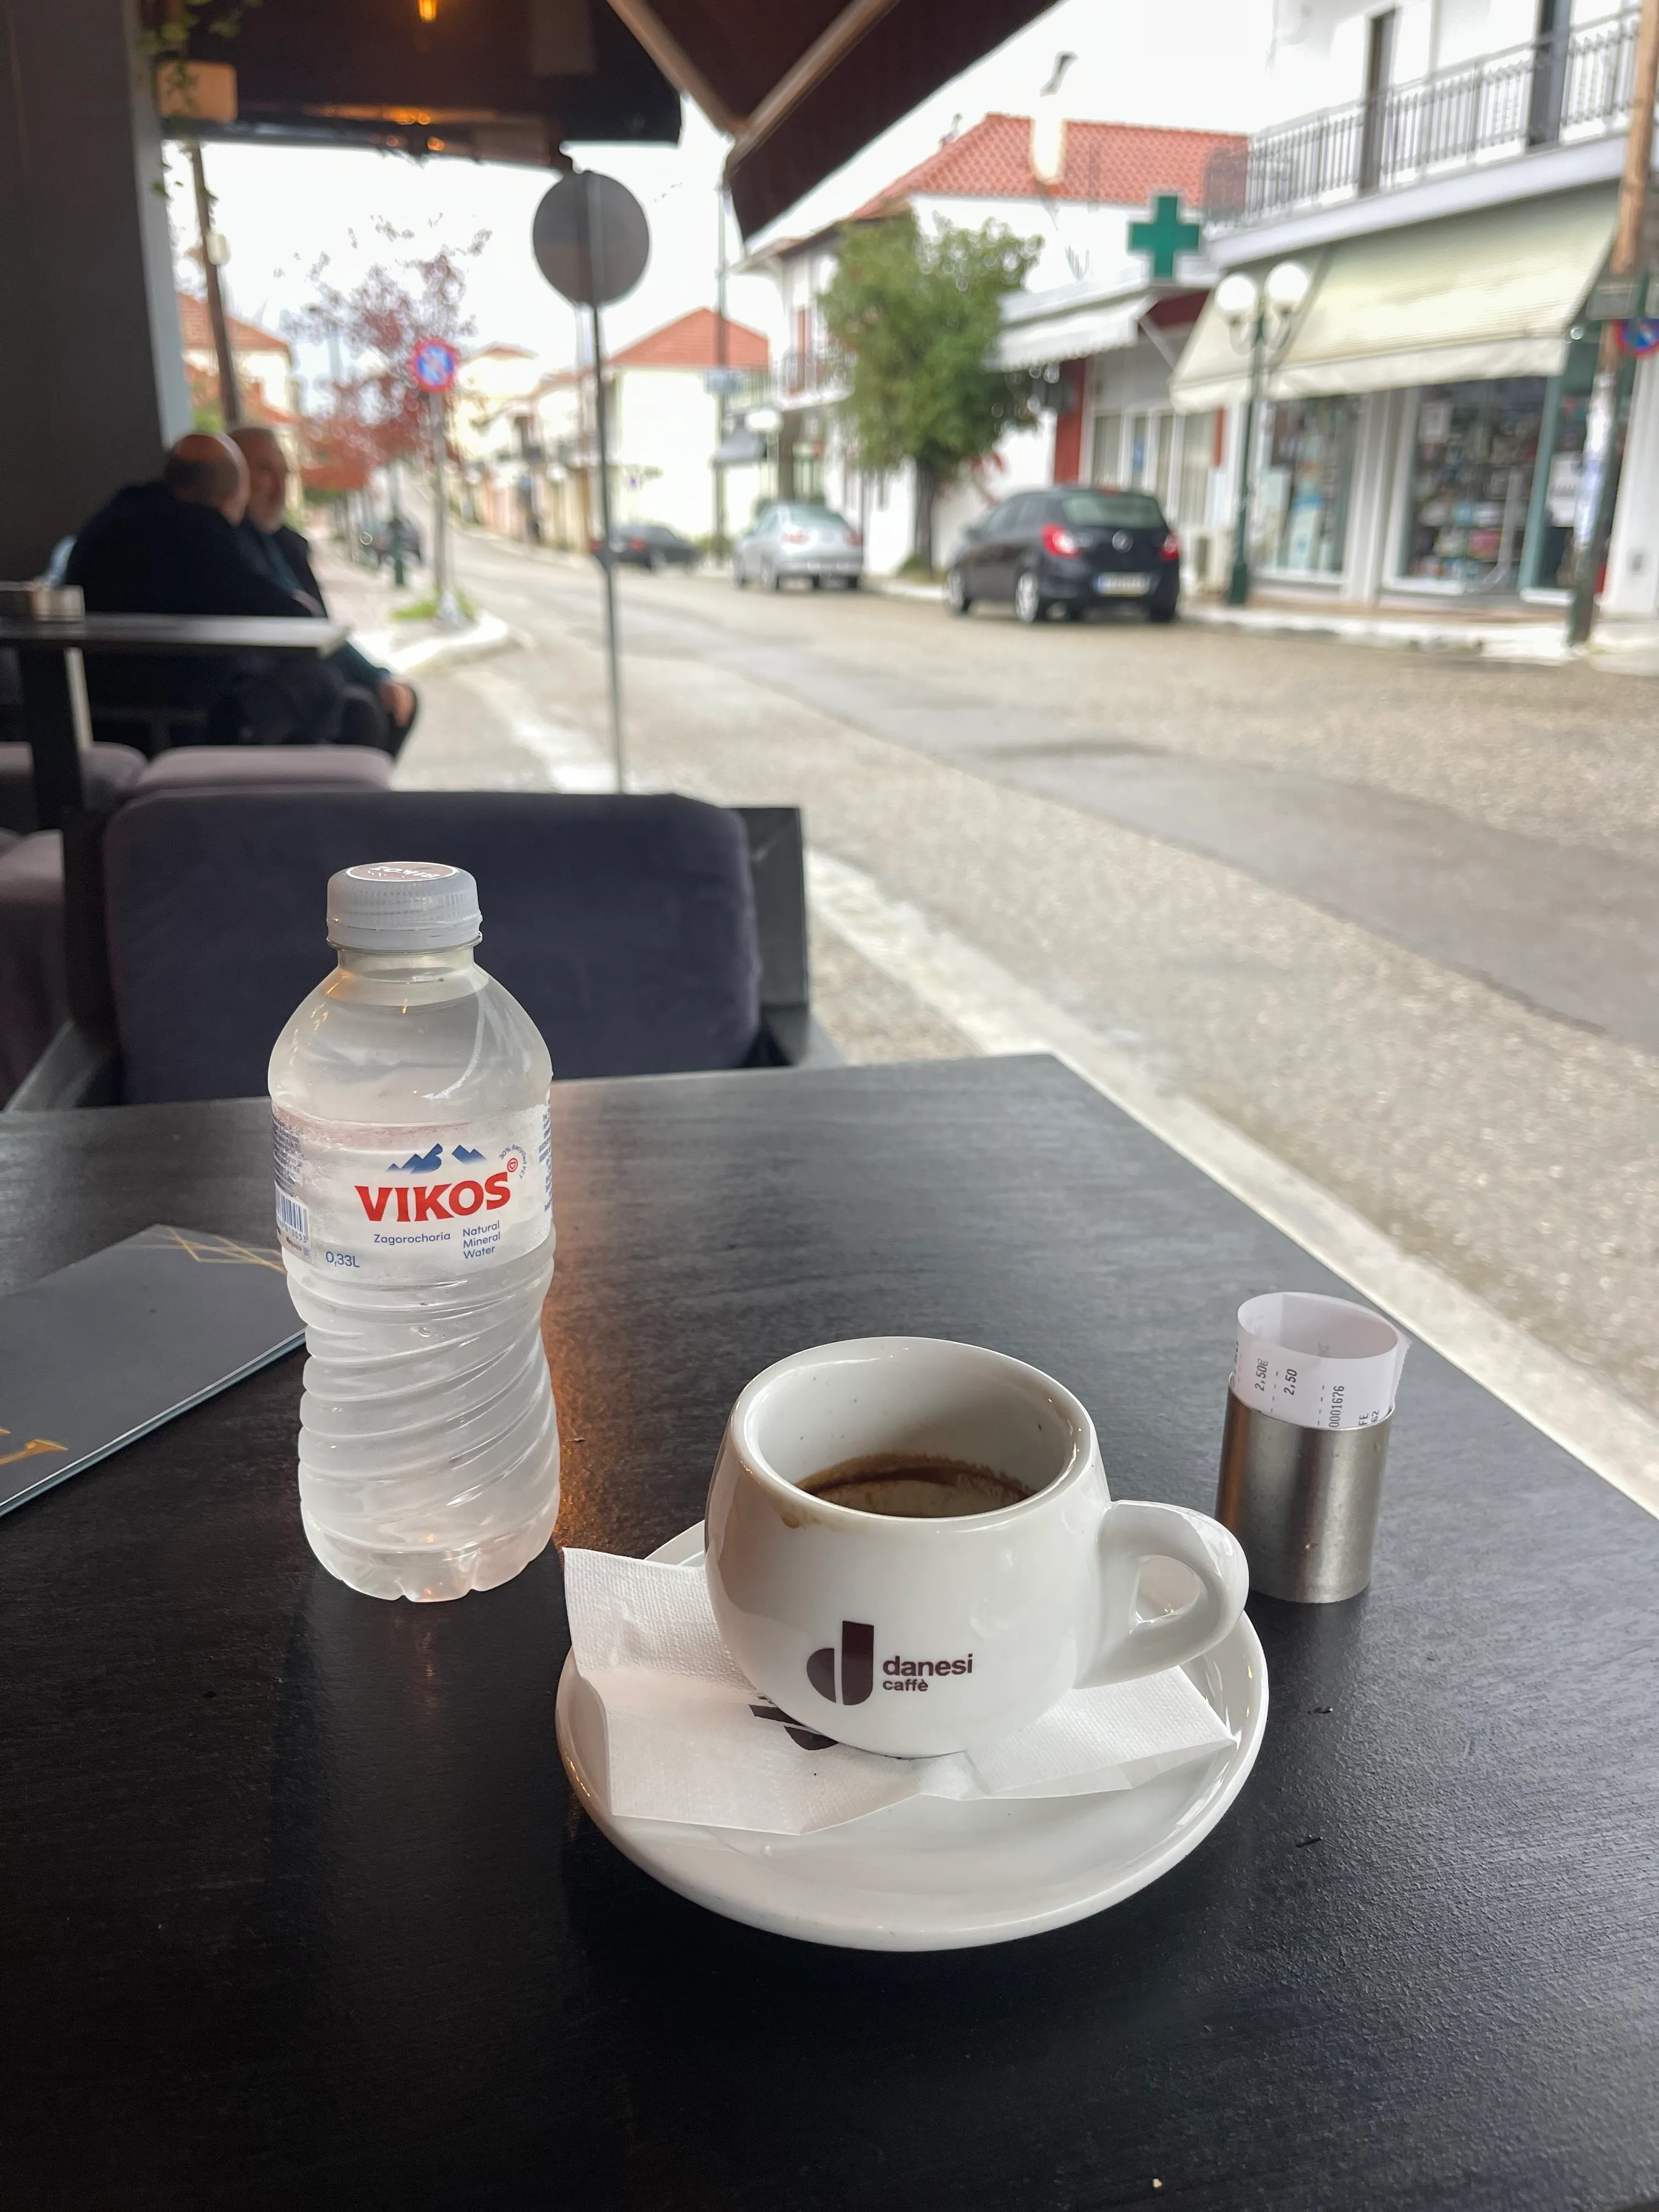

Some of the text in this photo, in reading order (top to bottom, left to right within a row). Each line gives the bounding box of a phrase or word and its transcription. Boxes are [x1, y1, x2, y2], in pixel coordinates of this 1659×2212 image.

[499, 1147, 511, 1160] 30%
[512, 1144, 527, 1164] Recycled
[354, 1172, 511, 1222] VIKOS
[463, 1221, 500, 1237] Natural
[374, 1232, 451, 1245] Zagorochoria
[463, 1233, 500, 1249] Mineral
[326, 1251, 360, 1268] 0,33L
[464, 1246, 495, 1260] Water
[1255, 1358, 1268, 1391] 2,50€
[1284, 1369, 1297, 1395] 2,50
[883, 1654, 973, 1676] danesi
[883, 1679, 928, 1691] caffè
